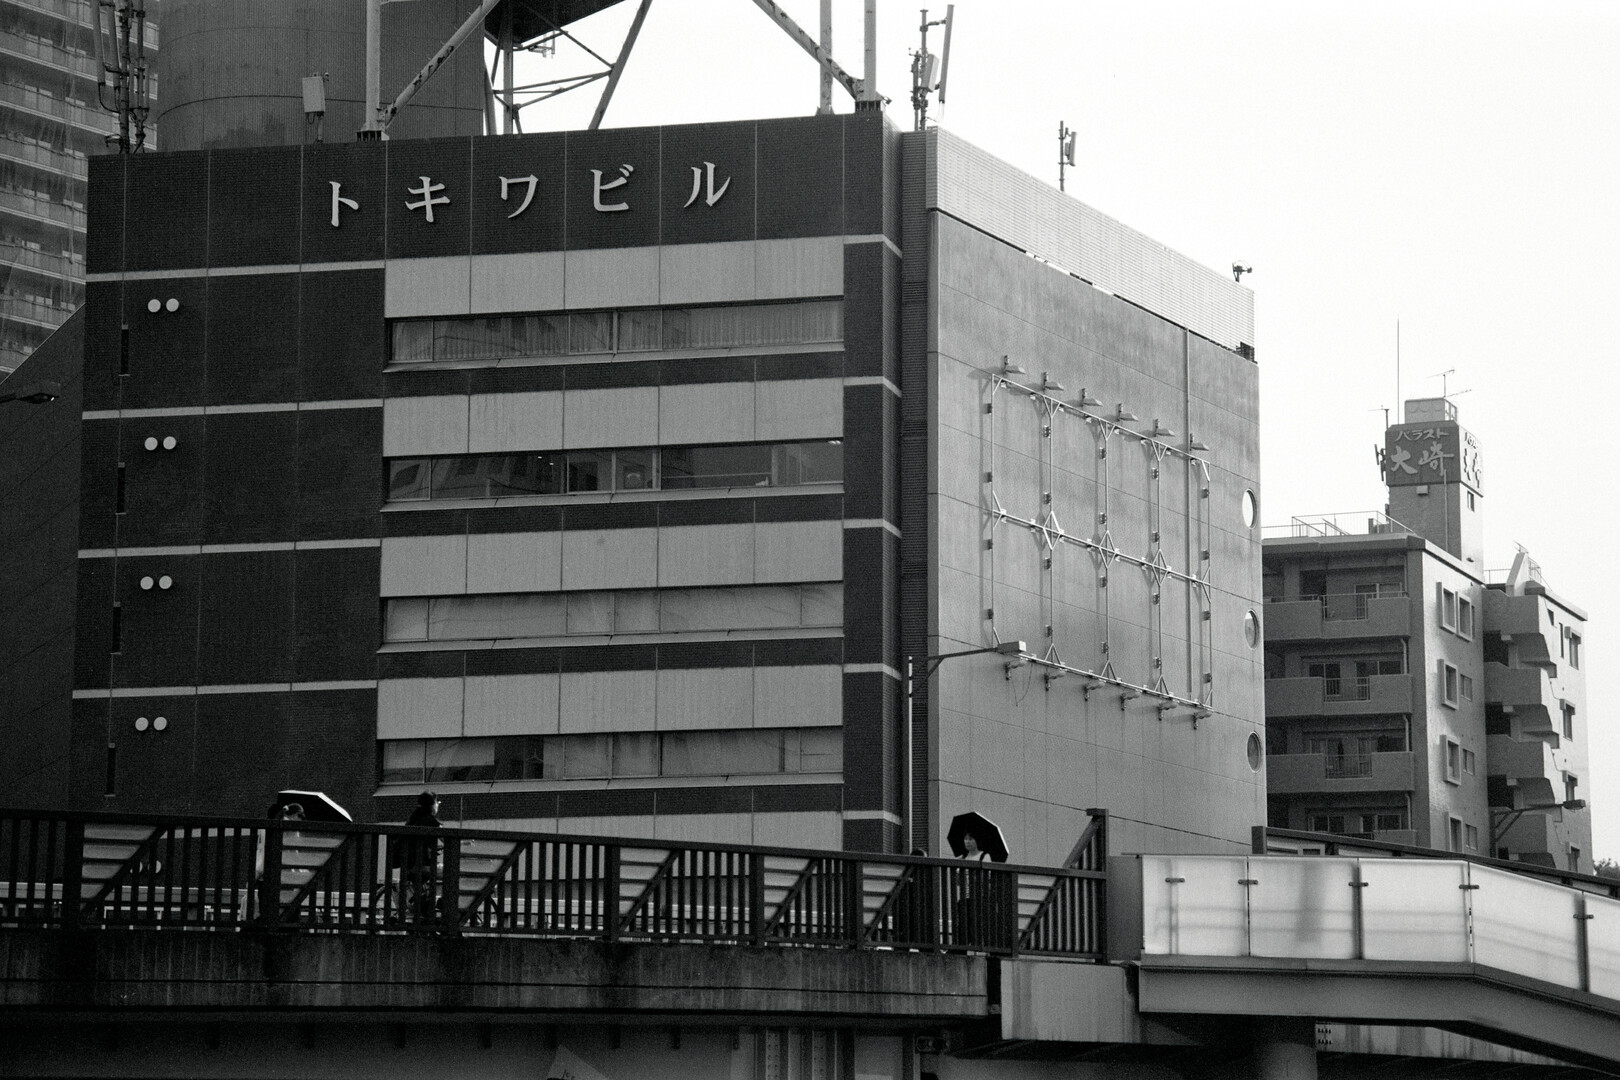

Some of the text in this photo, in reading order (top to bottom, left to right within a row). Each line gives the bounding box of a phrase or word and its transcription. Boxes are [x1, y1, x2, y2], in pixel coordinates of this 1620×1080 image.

[329, 161, 731, 227] トキワビル
[1390, 441, 1454, 476] 大崎
